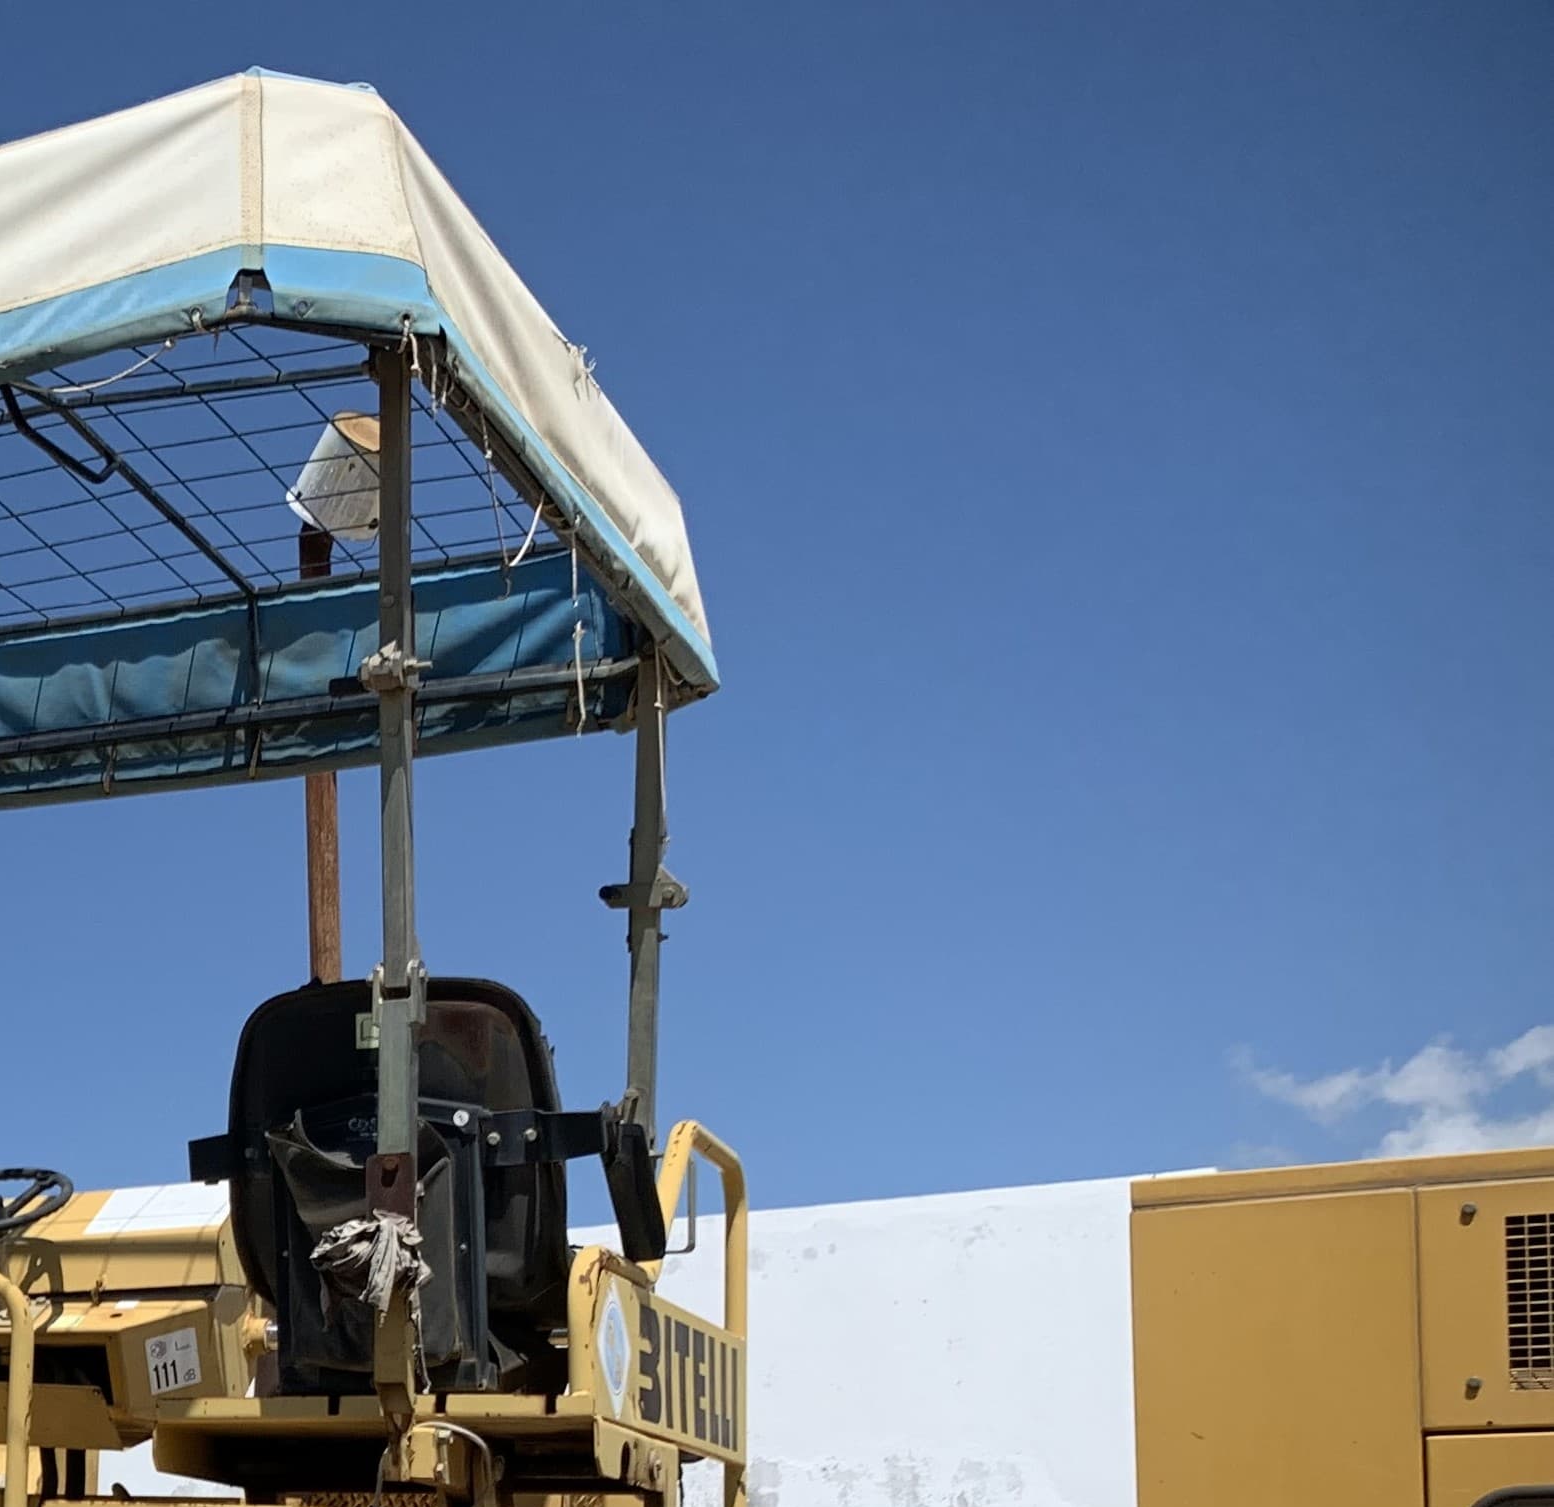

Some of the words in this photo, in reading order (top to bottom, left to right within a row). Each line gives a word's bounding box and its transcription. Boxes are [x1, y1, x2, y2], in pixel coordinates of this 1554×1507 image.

[152, 1359, 178, 1390] 111
[183, 1368, 197, 1382] dB
[639, 1303, 738, 1453] BITELLI
